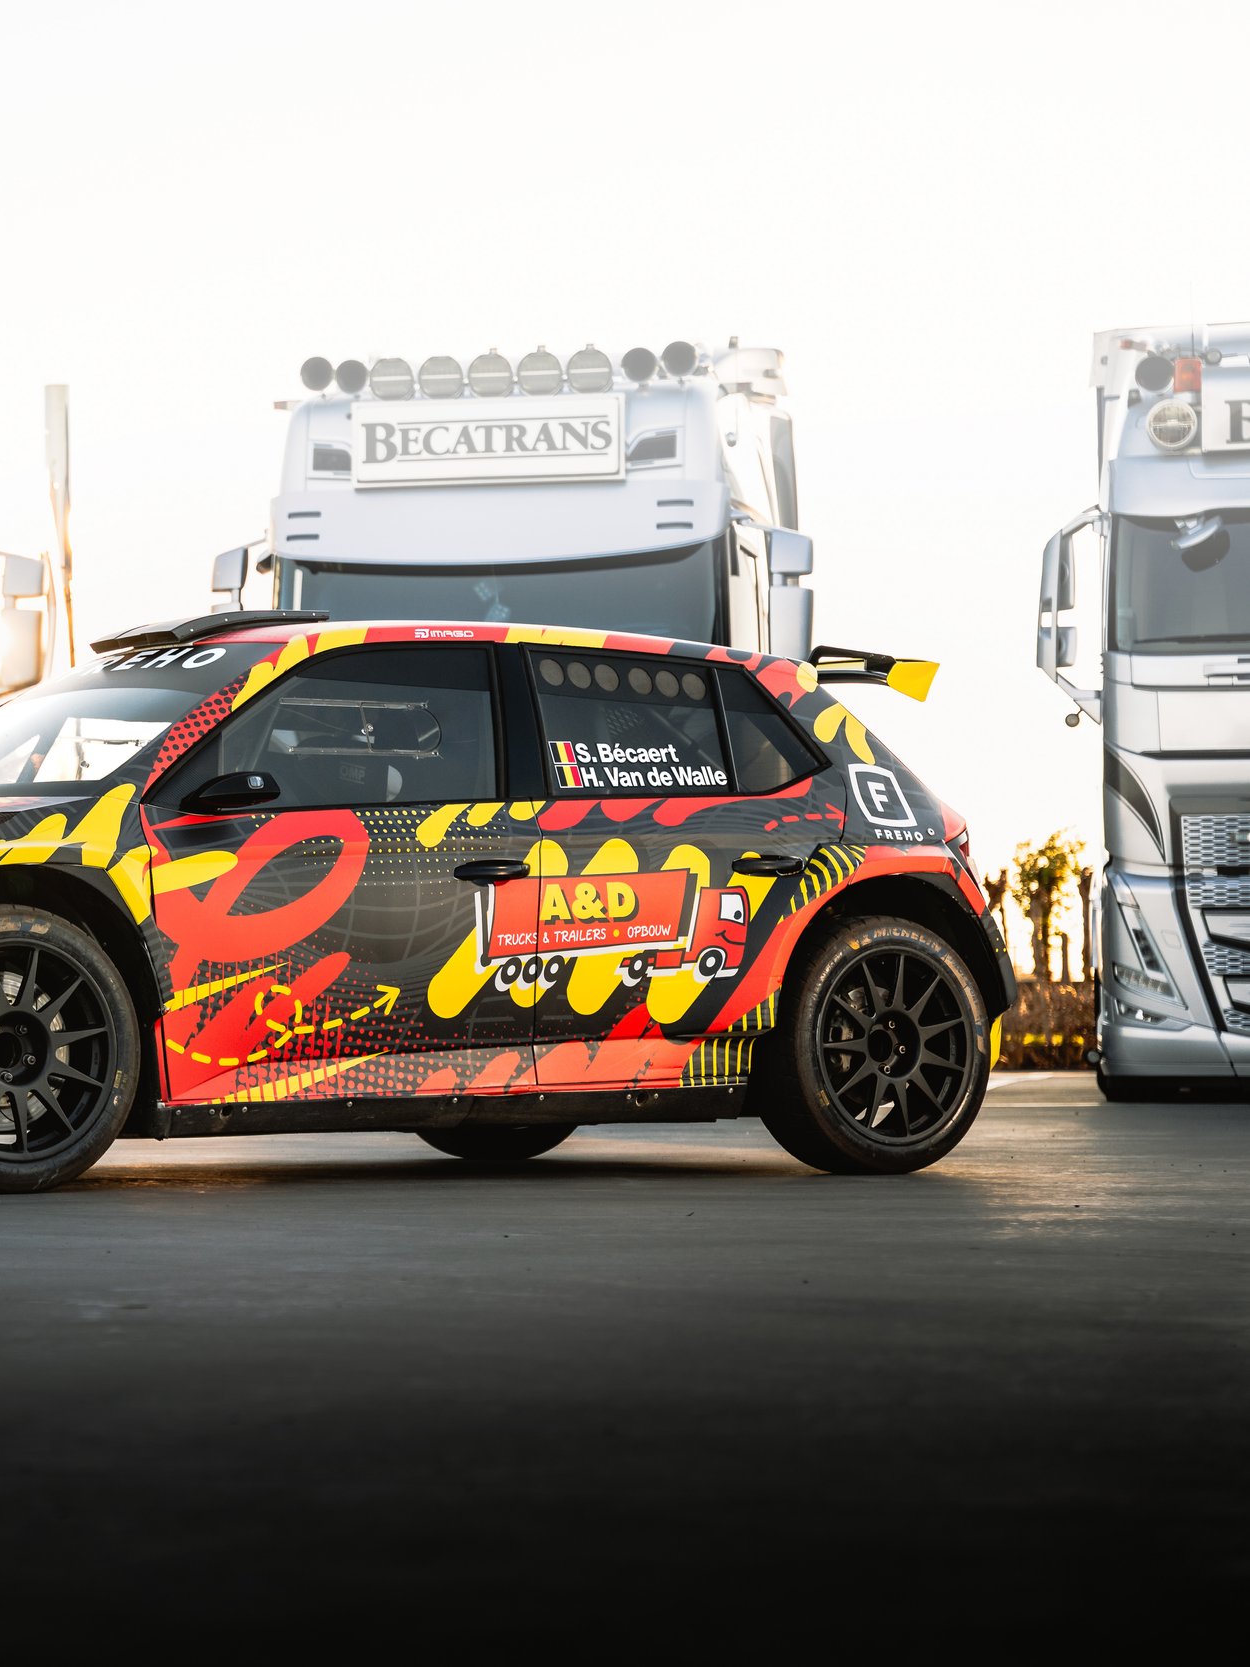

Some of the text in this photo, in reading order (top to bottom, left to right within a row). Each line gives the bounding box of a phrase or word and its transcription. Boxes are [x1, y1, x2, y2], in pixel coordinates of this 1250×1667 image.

[361, 420, 612, 464] BECATRANS
[430, 630, 474, 638] IMAGO
[575, 742, 680, 763] S. Bécaert
[581, 765, 728, 787] H. Van de Walle
[874, 829, 924, 841] FREHO
[539, 881, 641, 924] A&D
[497, 924, 672, 946] TRUCKS & TRAILERS OPBOUW
